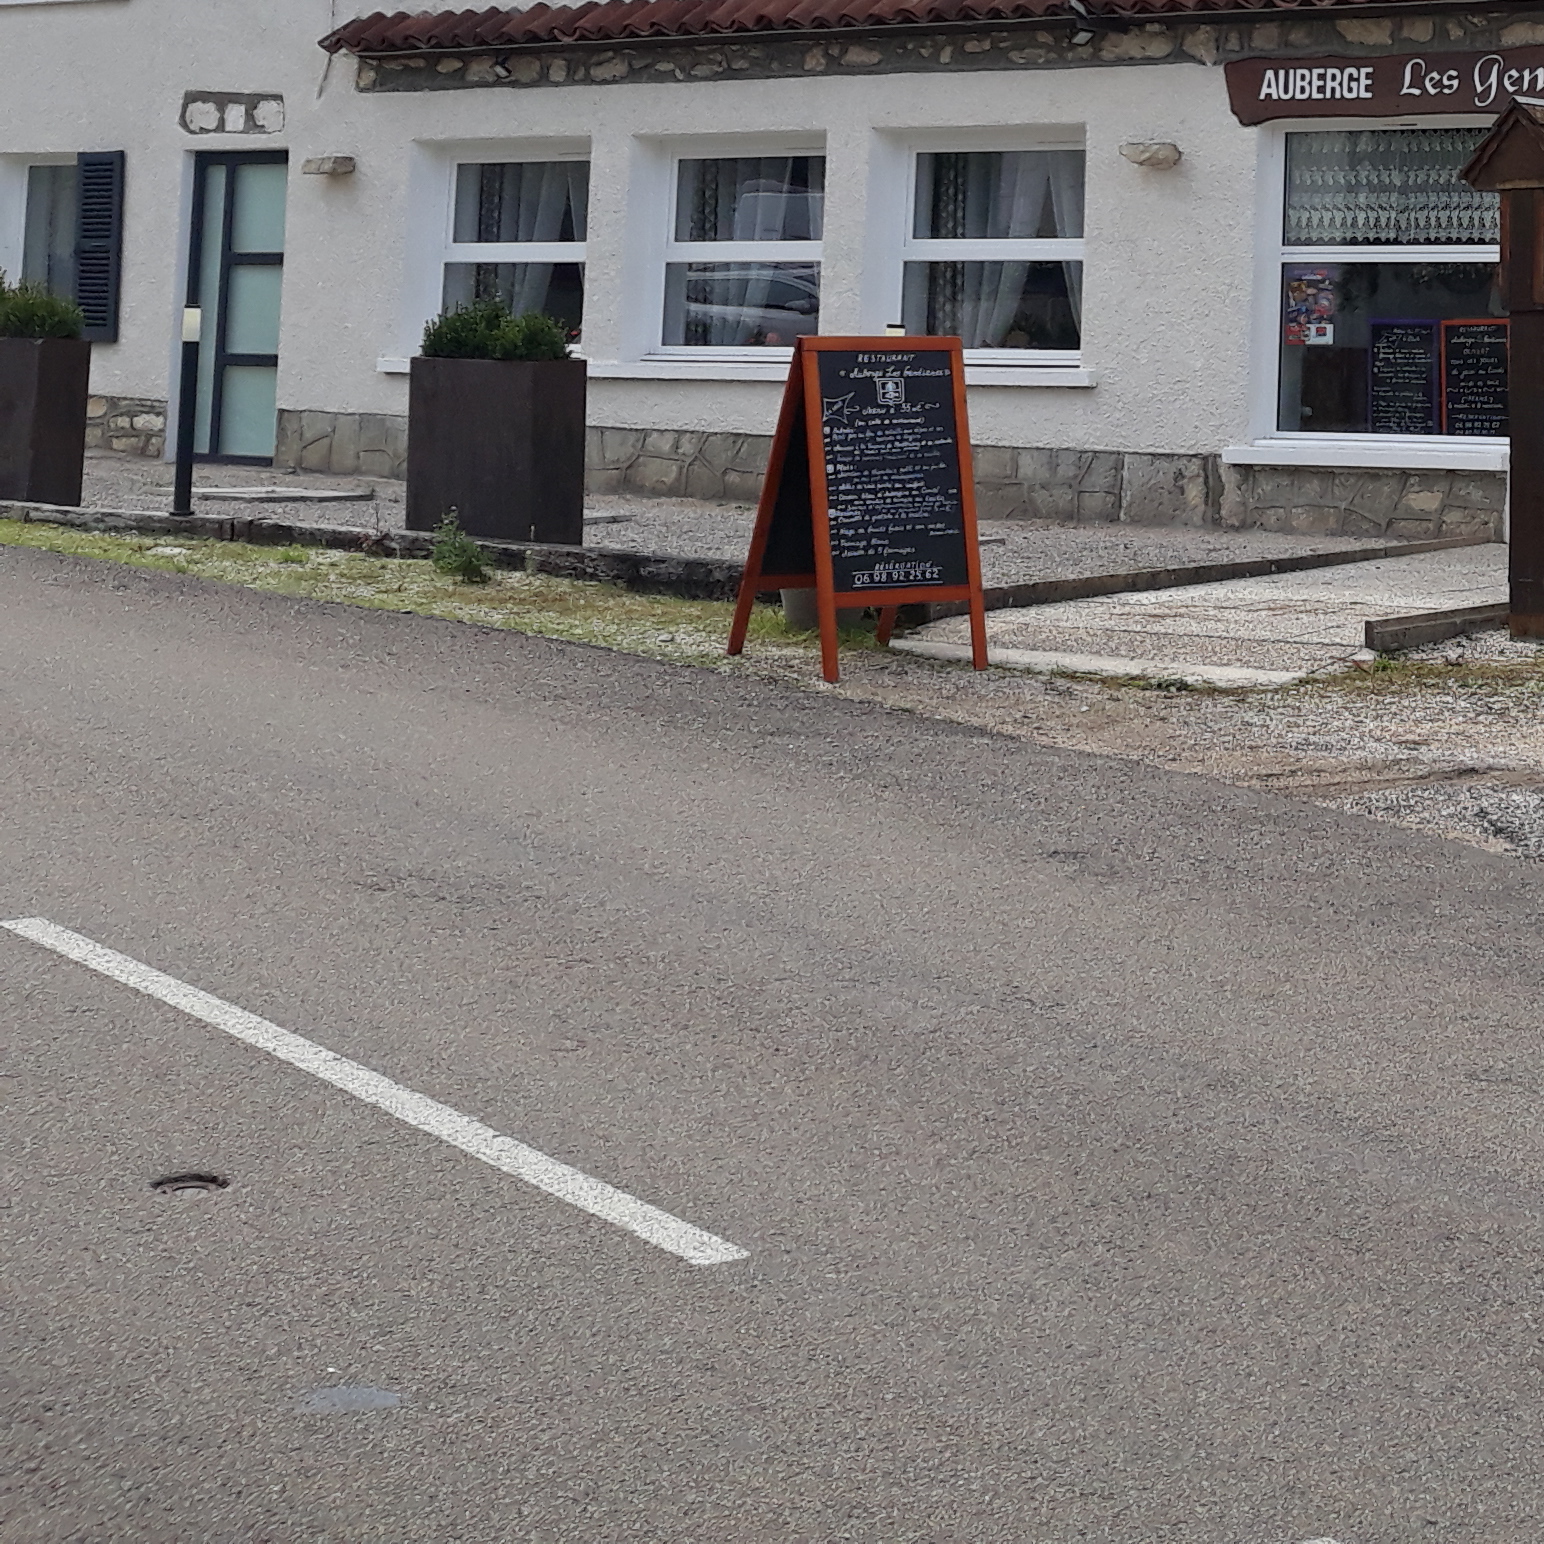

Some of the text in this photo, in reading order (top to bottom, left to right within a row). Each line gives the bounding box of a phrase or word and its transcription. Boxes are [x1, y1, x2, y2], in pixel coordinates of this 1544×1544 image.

[1259, 67, 1374, 100] AUBERGE
[1400, 58, 1459, 96] Les
[858, 354, 916, 363] RESTAURANT
